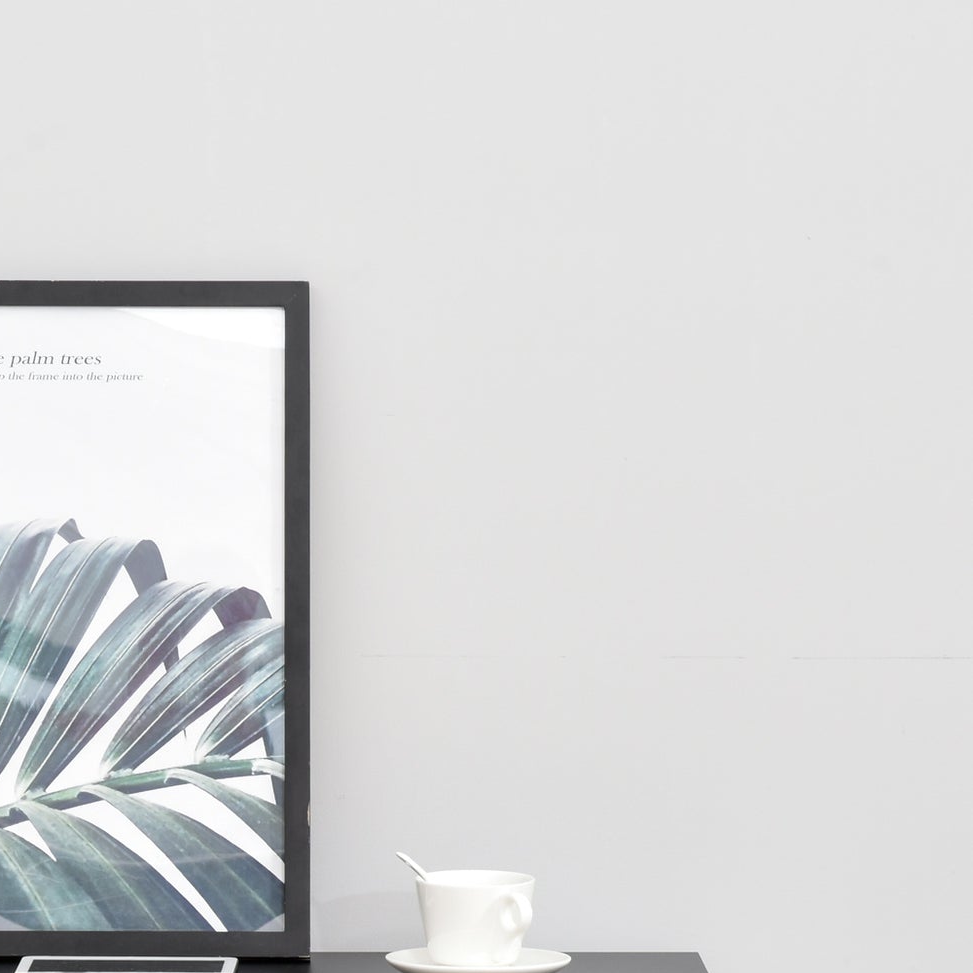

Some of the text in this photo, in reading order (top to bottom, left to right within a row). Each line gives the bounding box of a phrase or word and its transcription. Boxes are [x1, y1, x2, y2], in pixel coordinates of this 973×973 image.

[9, 350, 54, 368] palm
[60, 353, 102, 365] trees
[8, 371, 25, 381] the
[28, 371, 60, 381] frame
[62, 371, 84, 381] into
[86, 371, 104, 381] the
[106, 371, 144, 383] picture
